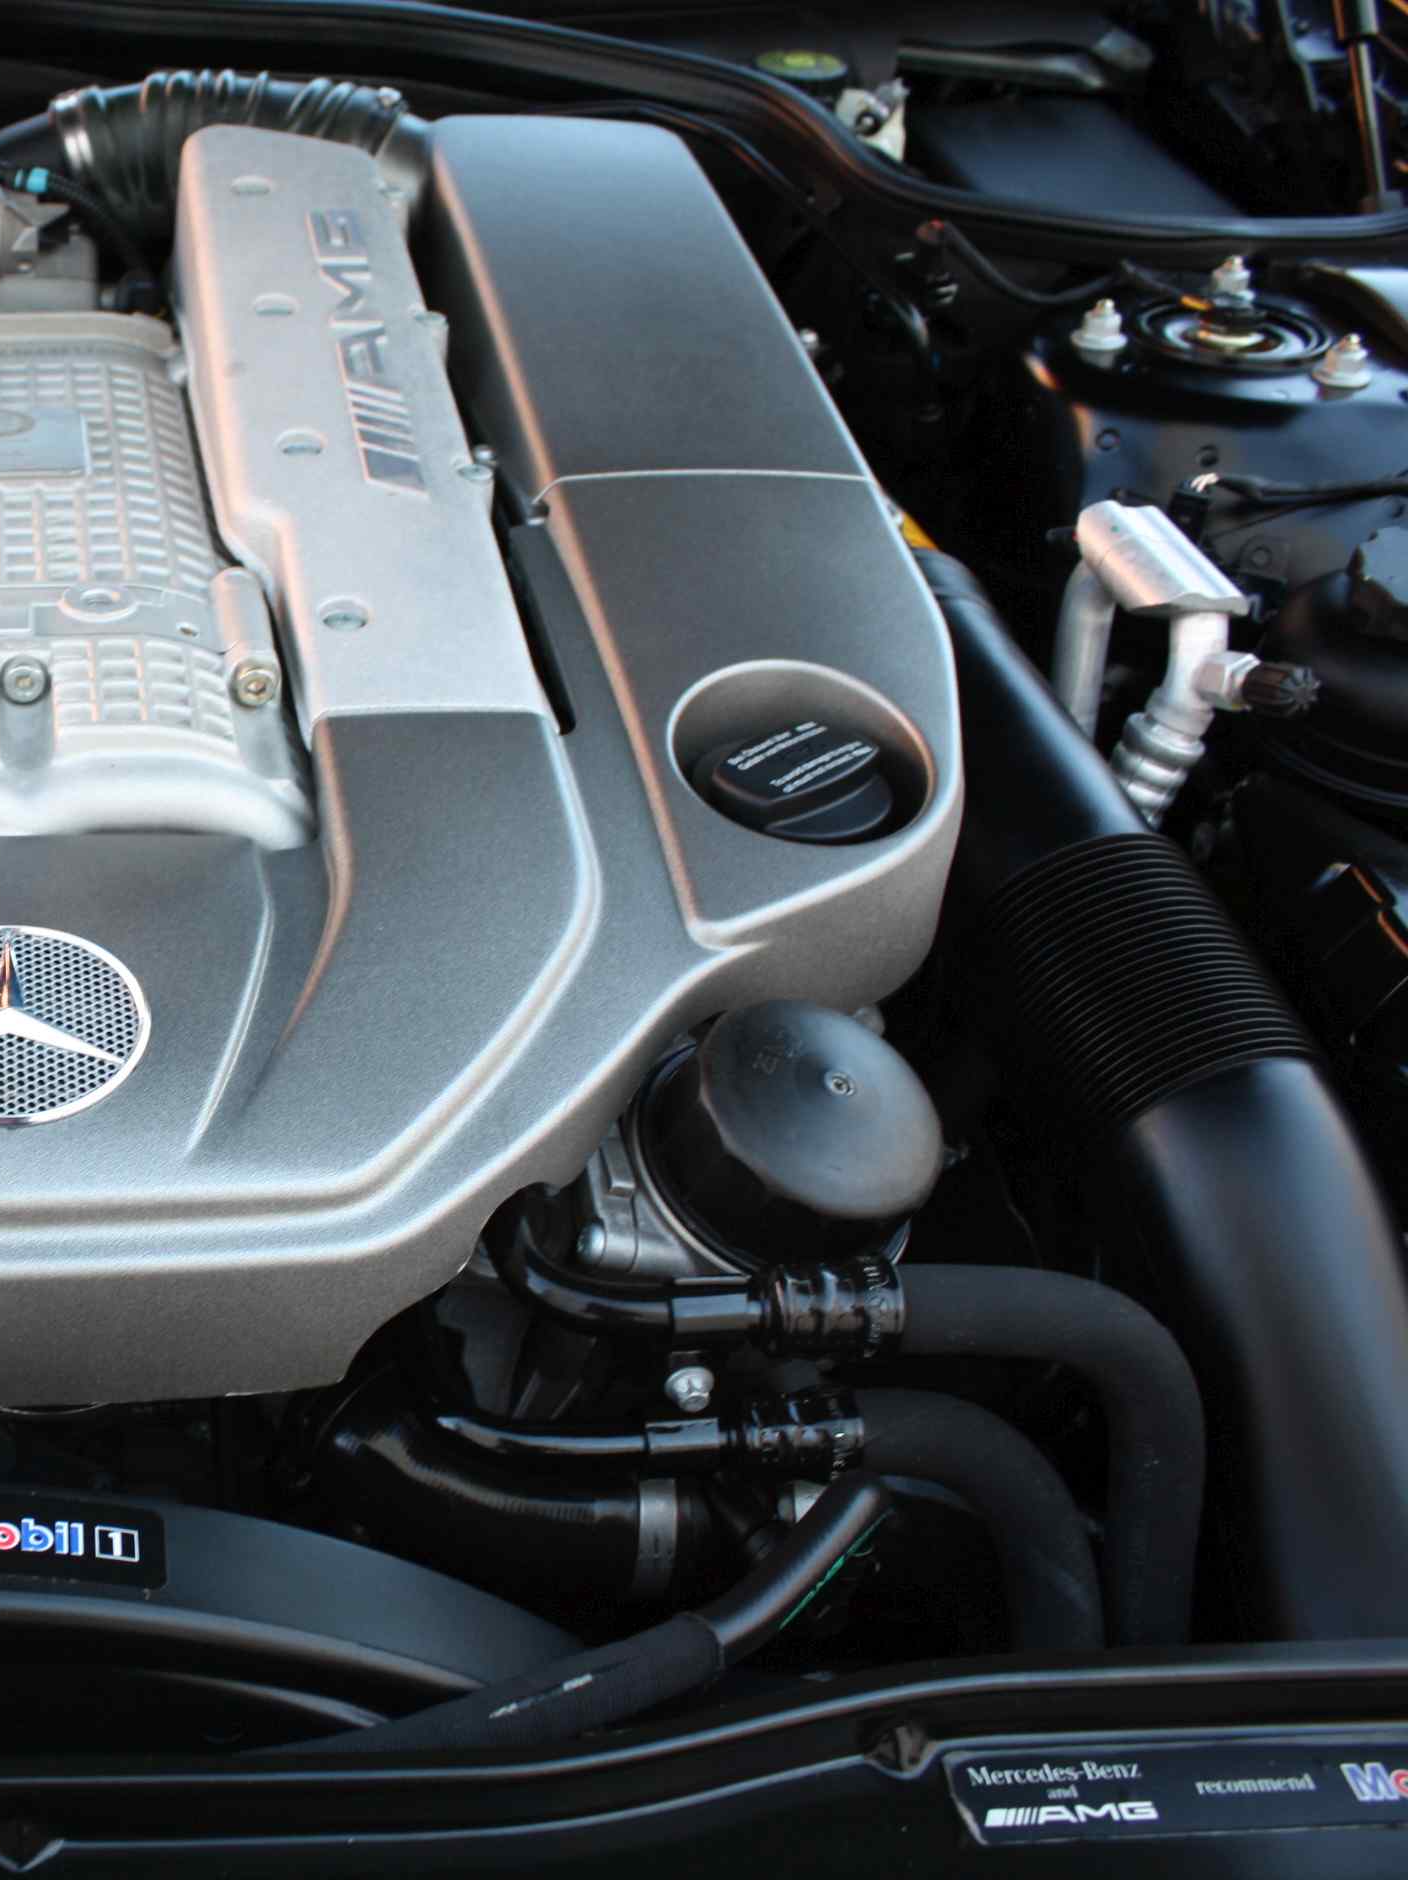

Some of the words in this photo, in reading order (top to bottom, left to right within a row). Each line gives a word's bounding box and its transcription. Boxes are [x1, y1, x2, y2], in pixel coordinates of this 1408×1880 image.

[967, 1760, 1143, 1787] Mercedes-Benz
[1195, 1772, 1317, 1795] recommend
[1046, 1784, 1079, 1800] and
[1037, 1800, 1159, 1826] AMG
